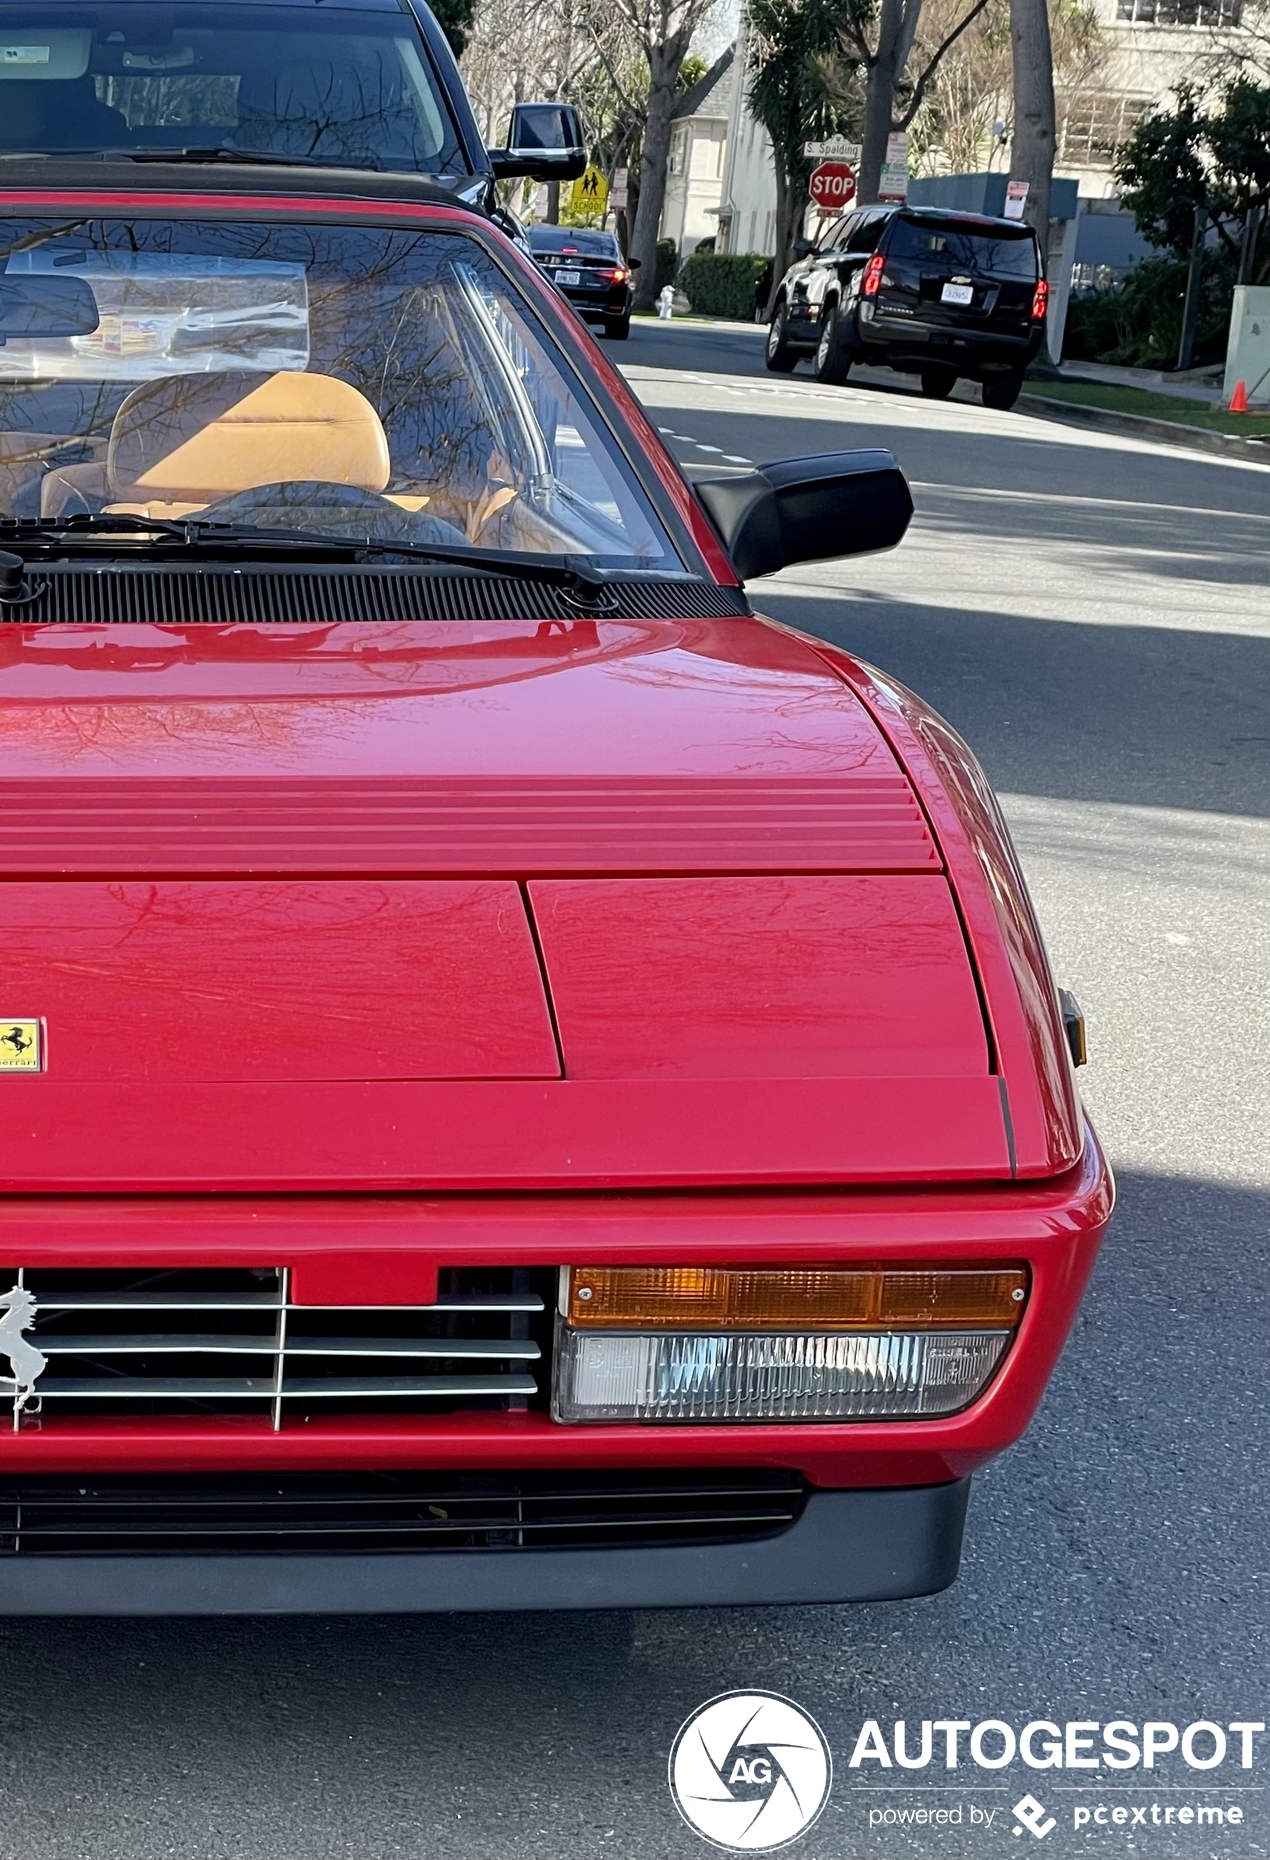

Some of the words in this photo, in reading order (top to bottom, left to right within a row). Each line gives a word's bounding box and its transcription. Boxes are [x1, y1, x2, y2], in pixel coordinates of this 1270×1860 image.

[806, 142, 815, 153] S.
[819, 143, 859, 158] Spalding
[813, 176, 854, 194] STOP
[573, 201, 604, 210] SCHOOL
